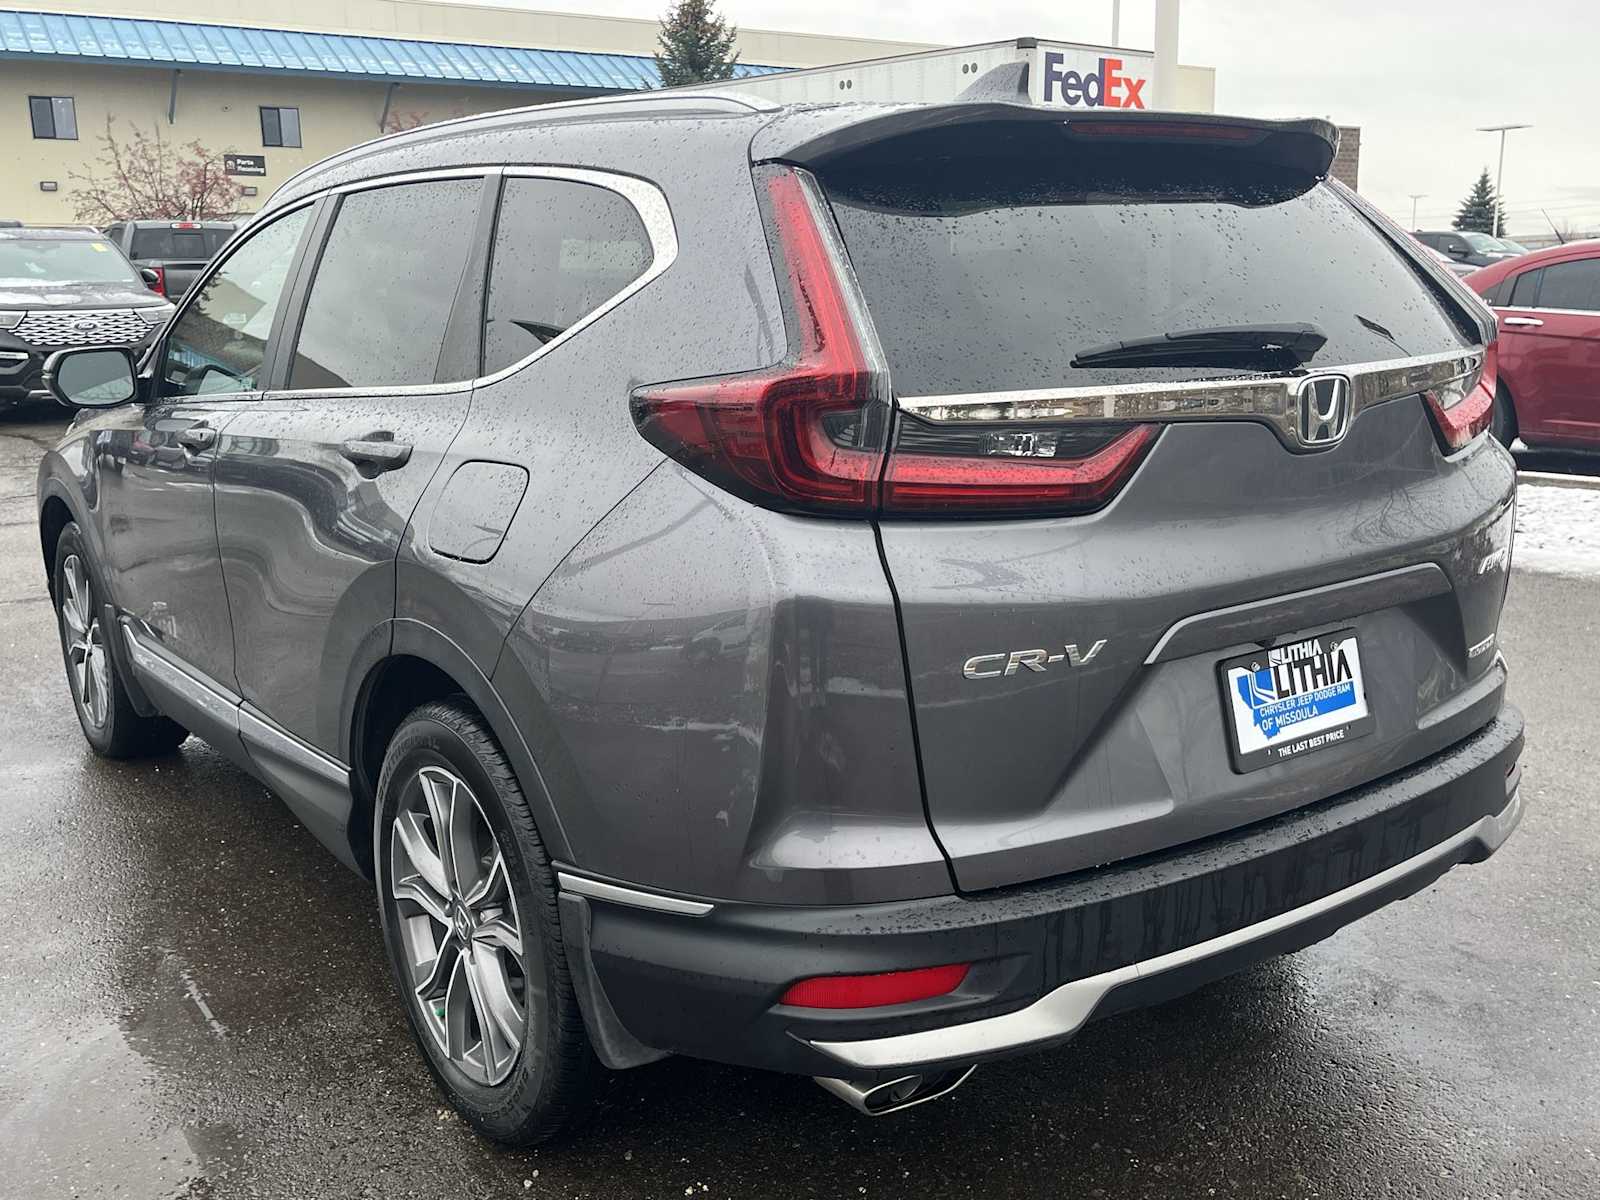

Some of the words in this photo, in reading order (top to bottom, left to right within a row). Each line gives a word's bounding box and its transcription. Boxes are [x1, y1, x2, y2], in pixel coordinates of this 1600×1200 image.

[1044, 52, 1146, 109] FedEx
[963, 639, 1107, 679] CR-V
[1281, 639, 1323, 664] LITHIA
[1273, 649, 1352, 699] LITHIA
[1259, 700, 1296, 718] CHRYSLER
[1297, 695, 1314, 707] JEEP
[1314, 688, 1337, 703] DODGE
[1337, 683, 1351, 697] RAM
[1261, 719, 1274, 731] OF
[1276, 706, 1319, 728] MISSOULA
[1277, 747, 1292, 758] THE
[1292, 741, 1309, 754] LAST
[1309, 735, 1325, 748] BEST
[1325, 729, 1345, 744] PRICE
